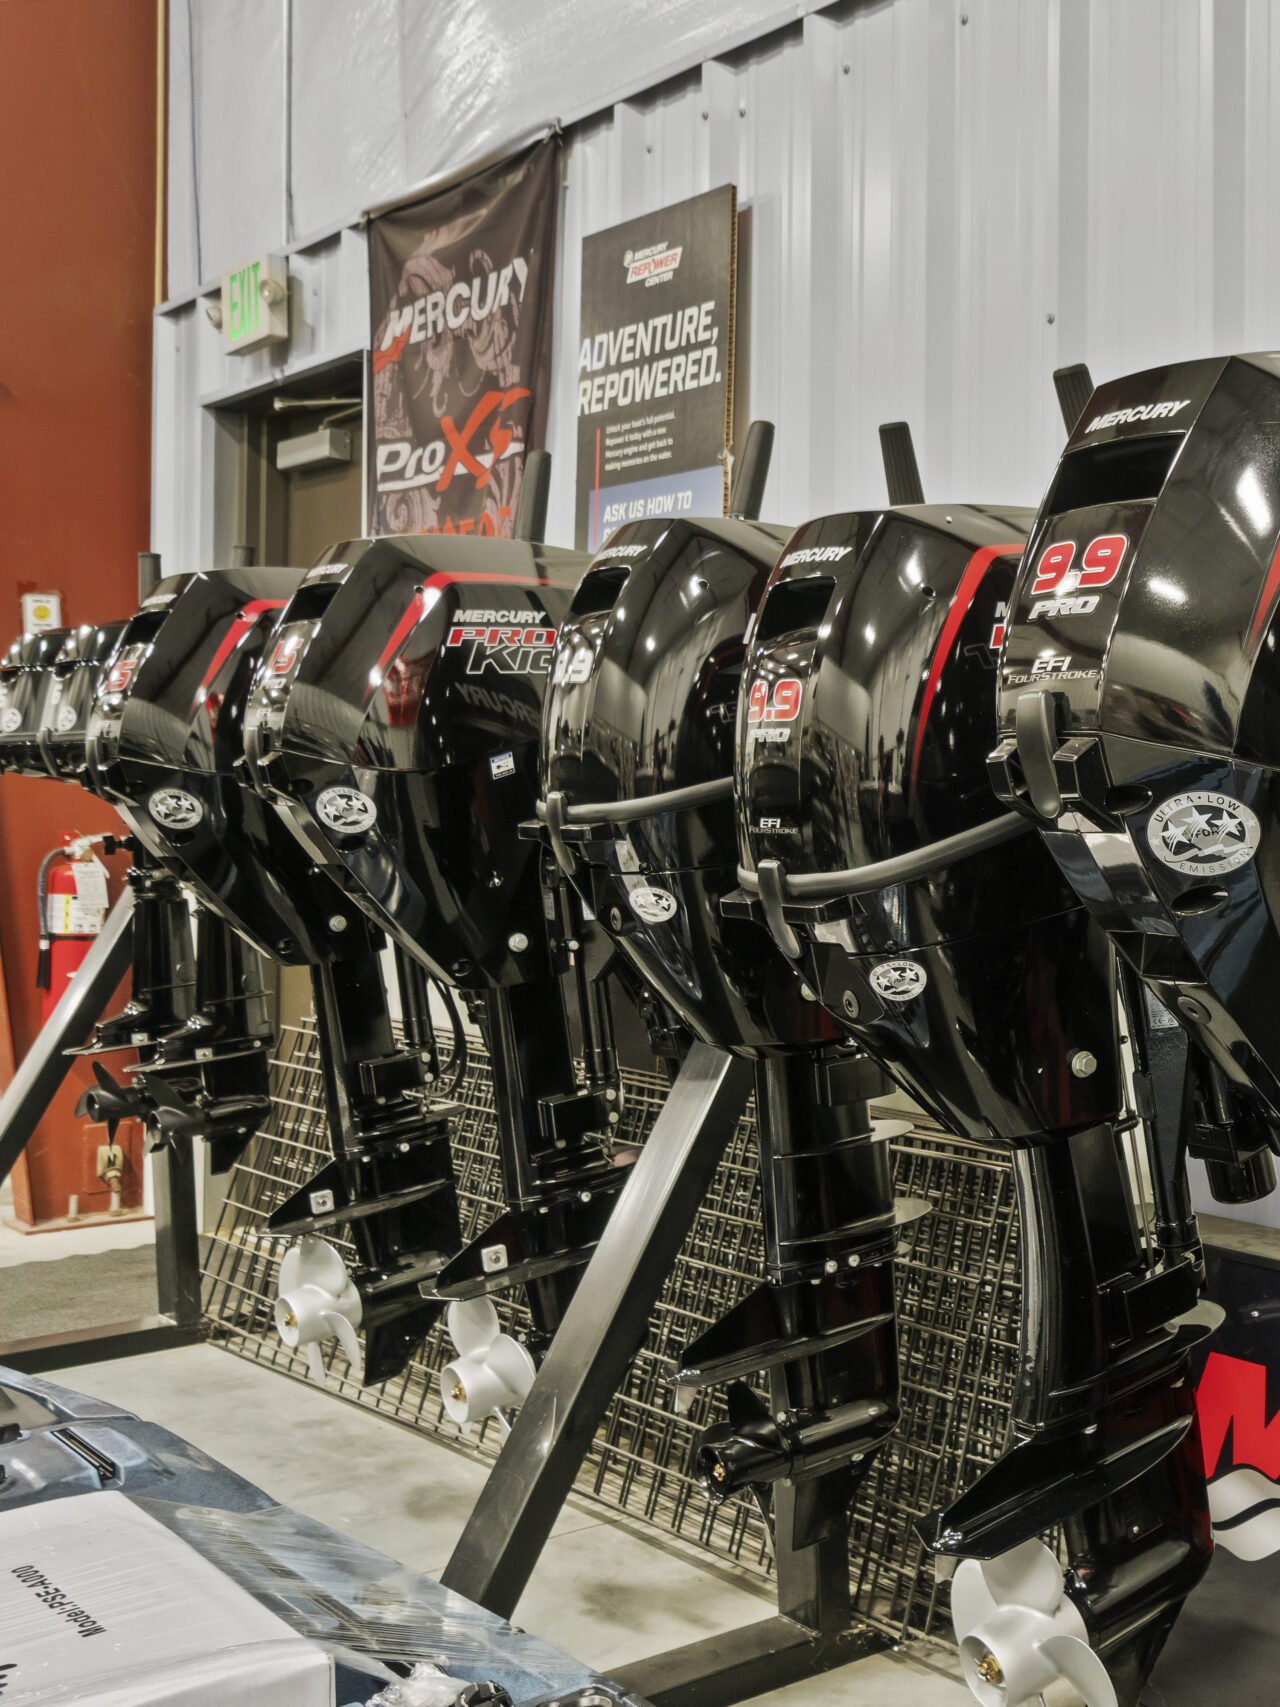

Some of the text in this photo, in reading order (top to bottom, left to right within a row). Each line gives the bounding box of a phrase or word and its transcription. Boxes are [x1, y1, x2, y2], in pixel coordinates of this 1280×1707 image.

[634, 241, 668, 260] MERCURY
[630, 252, 679, 279] REPOWER
[645, 271, 674, 287] CENTER
[229, 261, 260, 340] EXIT
[578, 300, 719, 378] ADVENTURE,
[578, 346, 722, 415] REPOWERED.
[1085, 400, 1191, 433] MERCURY
[603, 490, 693, 523] ASK US HOW TO
[780, 547, 853, 568] MERCURY
[453, 610, 546, 623] MERCURY
[1028, 596, 1100, 619] PRO
[447, 627, 558, 647] PRO
[1007, 669, 1098, 684] FOURSTROKE
[1031, 656, 1072, 674] EFI
[748, 679, 803, 723] 9.9
[748, 728, 791, 743] PRO
[1155, 794, 1240, 823] ULTRA LOW
[760, 818, 781, 829] EFI
[1179, 848, 1250, 874] EMISSION
